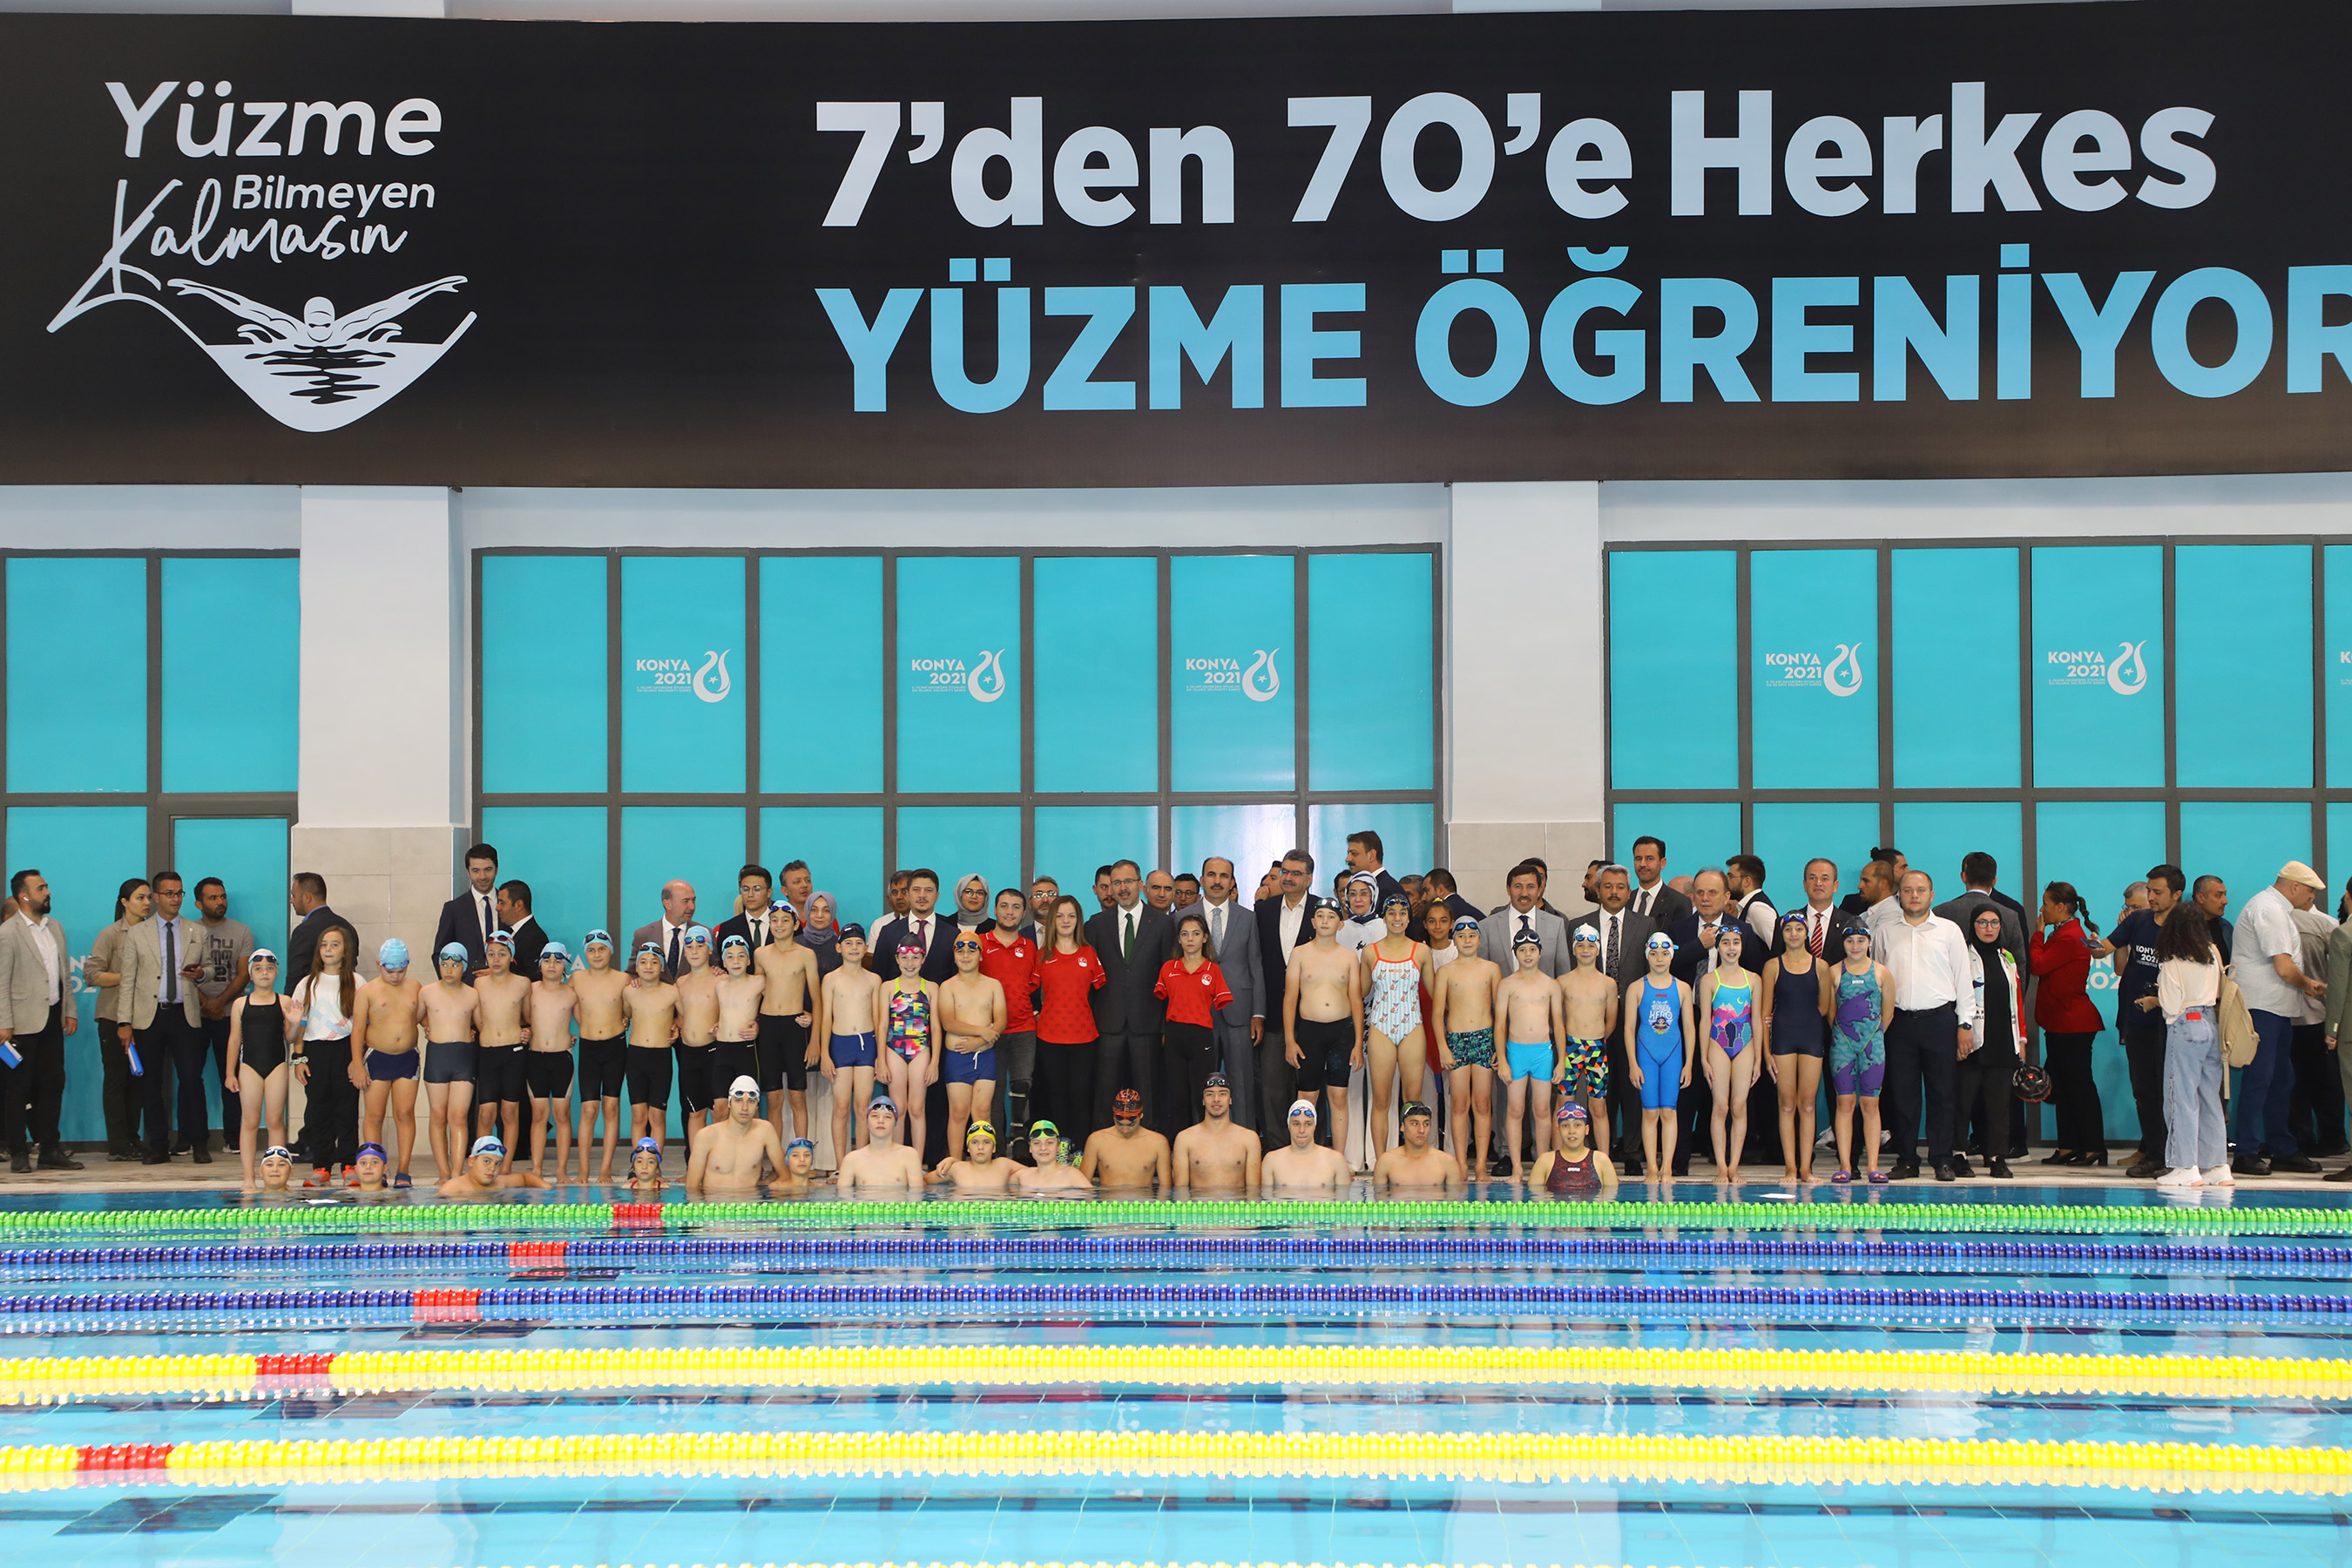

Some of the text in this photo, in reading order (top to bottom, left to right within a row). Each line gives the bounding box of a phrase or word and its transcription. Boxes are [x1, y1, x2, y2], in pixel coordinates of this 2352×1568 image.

[105, 80, 443, 159] Yüzme
[815, 81, 2217, 228] 7'den 70'e Herkes
[232, 173, 436, 218] Bilmeyen
[87, 177, 409, 294] Kalmasın
[814, 242, 2352, 414] YÜZME ÖĞRENİYOR
[1765, 652, 1821, 666] KONYA
[2048, 651, 2105, 664] KONYA
[636, 659, 692, 672] KONYA
[911, 659, 966, 672] KONYA
[1186, 658, 1240, 671] KONYA
[2066, 664, 2106, 677] 2021
[654, 672, 692, 685] 2021
[929, 672, 966, 685] 2021
[1204, 671, 1241, 684] 2021
[1784, 666, 1822, 679] 2021
[2136, 945, 2157, 956] KONY
